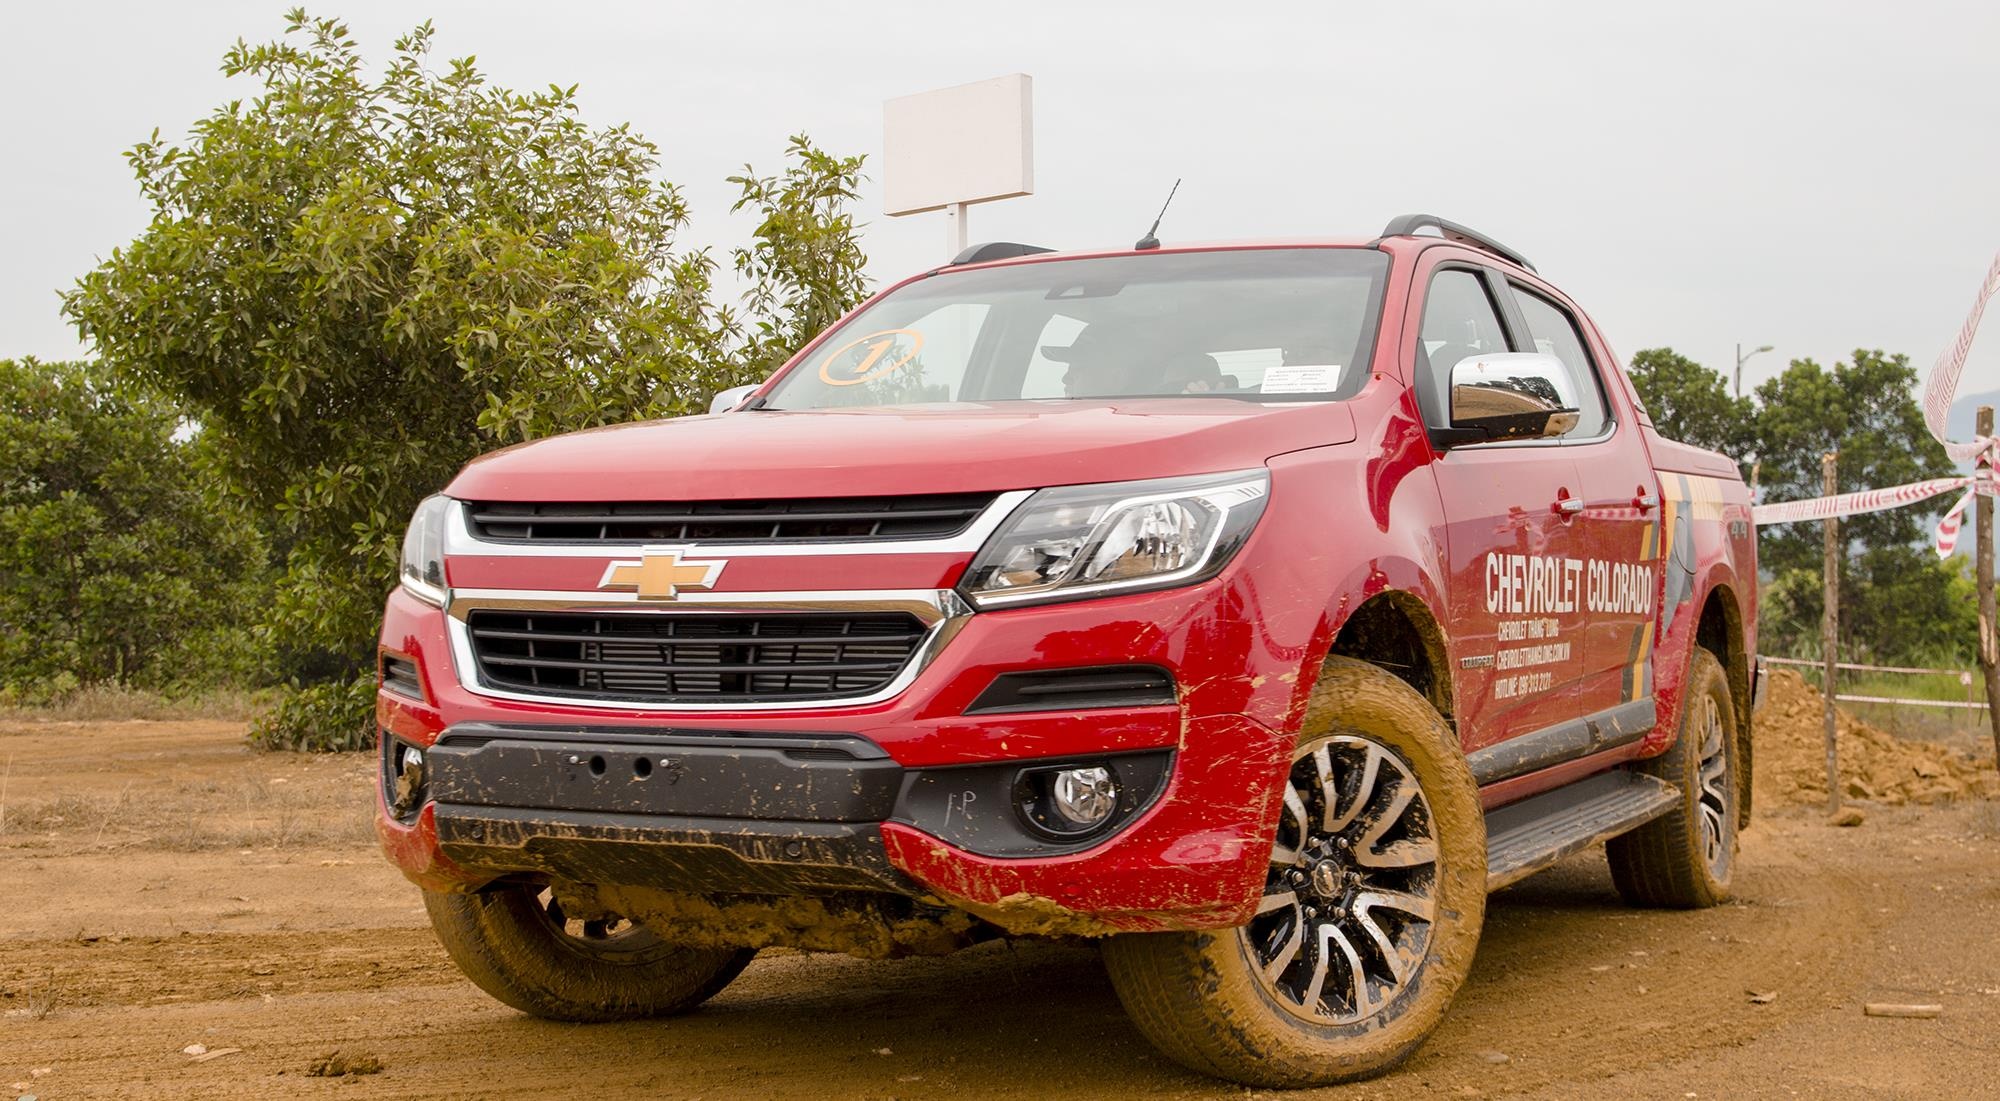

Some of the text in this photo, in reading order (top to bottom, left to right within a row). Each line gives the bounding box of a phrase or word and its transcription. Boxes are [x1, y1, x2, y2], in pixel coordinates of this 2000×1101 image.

[1486, 552, 1652, 614] CHEVROLET COLORADO
[1498, 621, 1527, 641] CHEVROLET
